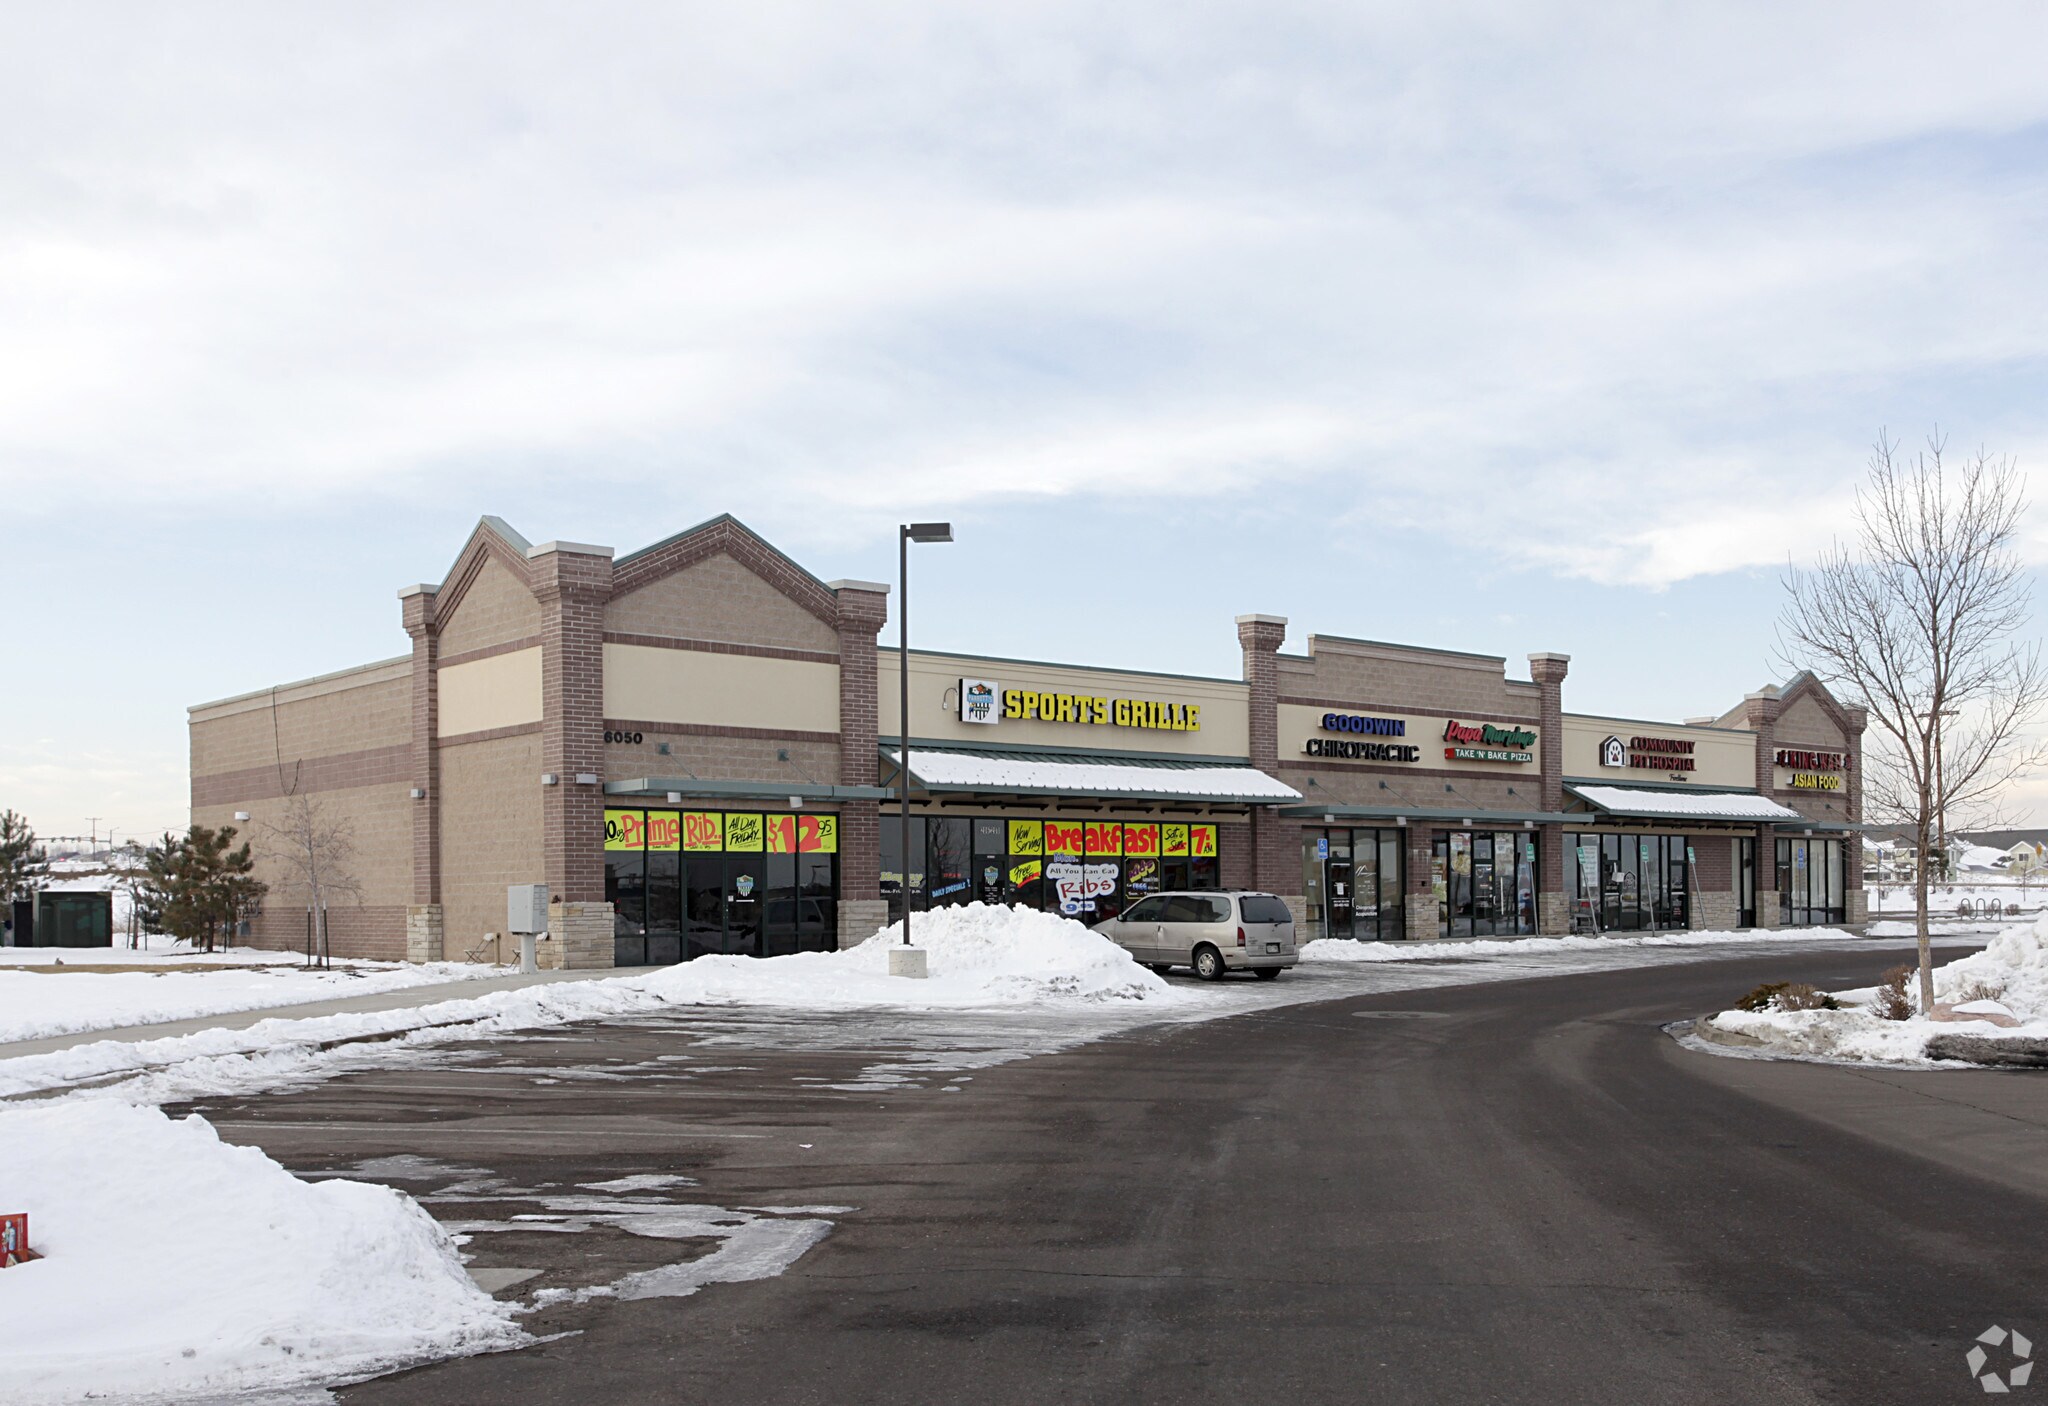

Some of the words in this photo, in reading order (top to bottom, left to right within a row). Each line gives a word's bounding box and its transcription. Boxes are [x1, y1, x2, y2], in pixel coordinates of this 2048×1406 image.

[1003, 690, 1108, 724] SPORTS
[1113, 699, 1200, 731] GRILLE
[1323, 713, 1405, 736] GOODWIN
[1444, 720, 1482, 744] Papa
[604, 731, 643, 744] 6050
[1631, 737, 1695, 753] COMMUNITY
[1306, 738, 1420, 762] CHIROPRACTIC
[1455, 749, 1475, 758] TAKE
[1487, 751, 1508, 760] BAKE
[1511, 753, 1531, 761] PIZZA
[1632, 754, 1650, 769] PET
[1651, 756, 1697, 771] HOSPITAL
[1788, 750, 1818, 770] KING
[1794, 774, 1817, 788] ASIAN
[1819, 775, 1839, 789] FOOD
[621, 815, 679, 845] Prime
[1013, 825, 1031, 841] Now
[1045, 823, 1159, 853] Breakfast
[1013, 836, 1042, 854] Serving
[1064, 867, 1080, 875] You
[1060, 879, 1112, 899] Ribs
